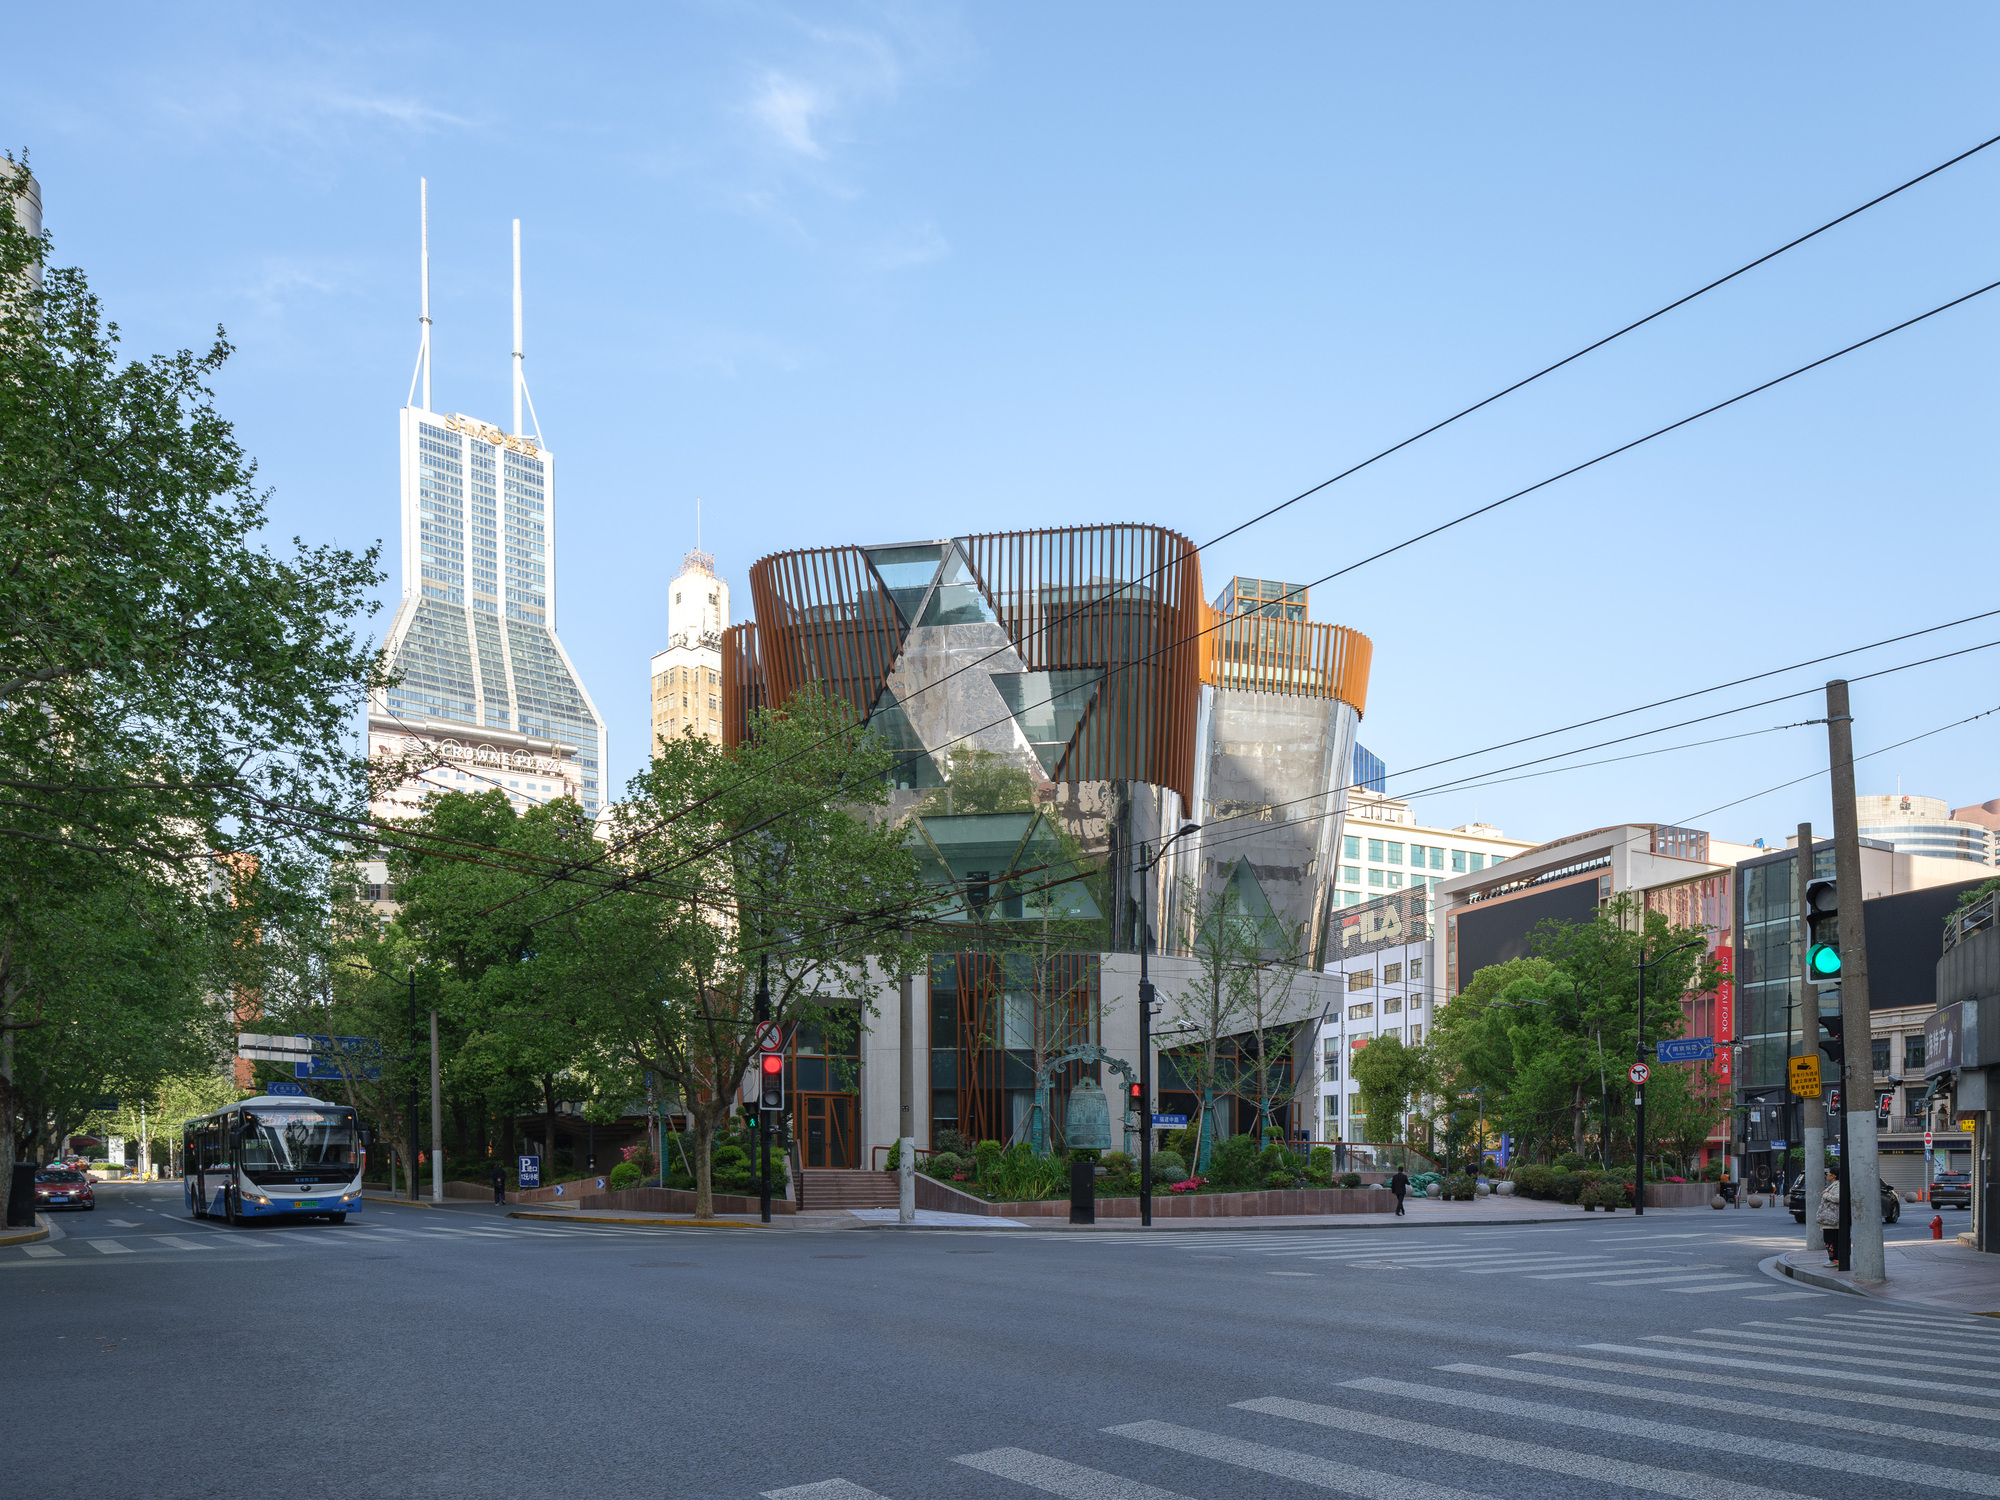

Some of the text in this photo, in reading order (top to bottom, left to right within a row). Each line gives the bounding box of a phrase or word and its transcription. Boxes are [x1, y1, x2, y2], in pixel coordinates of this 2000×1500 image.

[505, 433, 539, 459] 世茂
[442, 745, 565, 773] CROWNE PLAZA
[1342, 904, 1403, 949] FILA
[1721, 989, 1729, 1004] TAI
[1721, 1007, 1729, 1032] FOOK
[1672, 1044, 1698, 1052] 南京东路
[263, 1114, 283, 1125] 167
[521, 1158, 531, 1172] P
